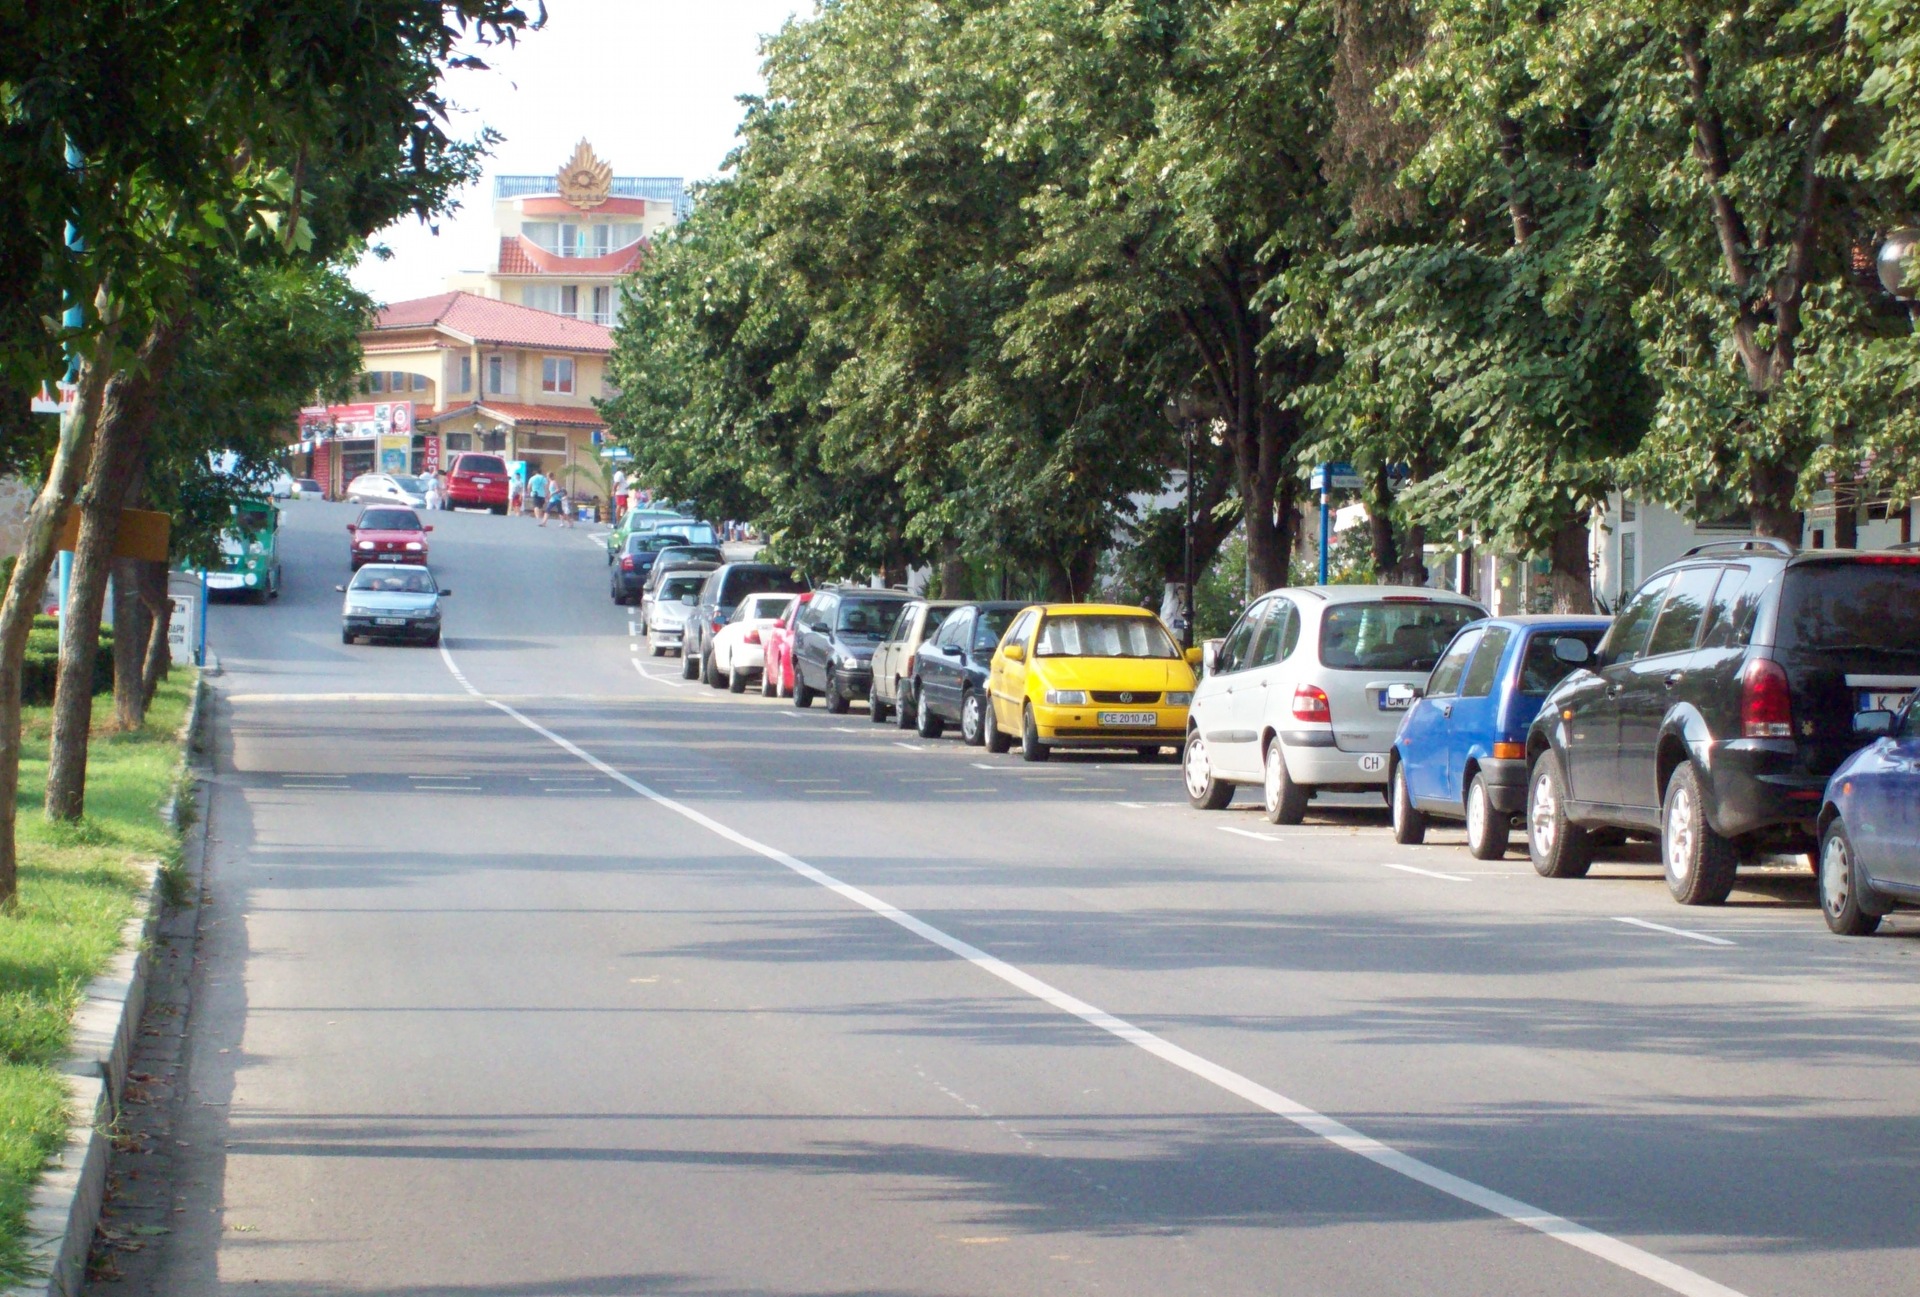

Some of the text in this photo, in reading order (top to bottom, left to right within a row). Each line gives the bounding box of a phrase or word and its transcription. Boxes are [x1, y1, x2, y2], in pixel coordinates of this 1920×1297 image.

[1104, 713, 1155, 723] CE 2010 AP
[1364, 756, 1379, 769] CH
